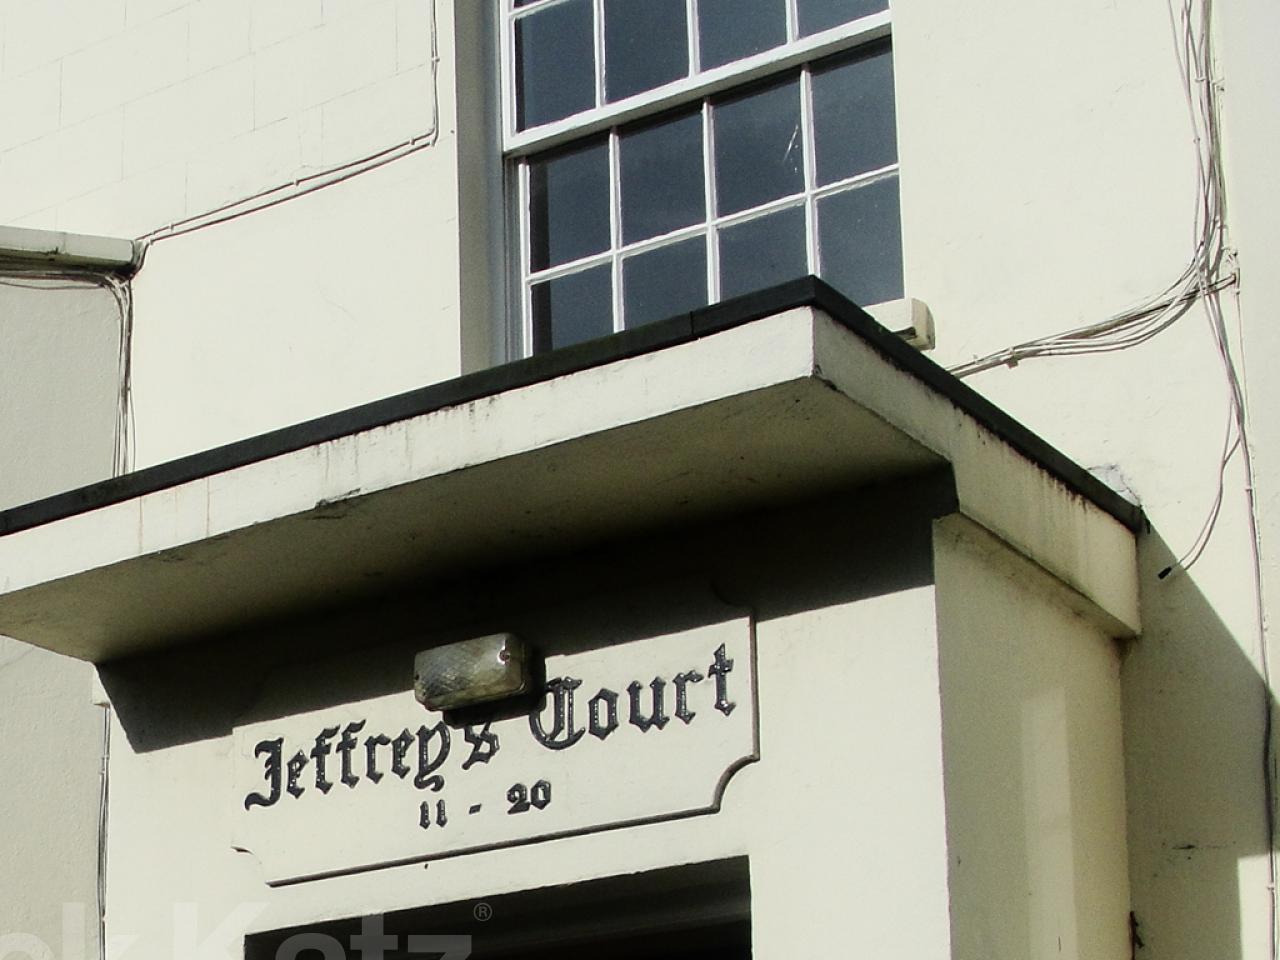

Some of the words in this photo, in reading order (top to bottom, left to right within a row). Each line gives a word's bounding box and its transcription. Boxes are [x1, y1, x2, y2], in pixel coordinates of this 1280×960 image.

[529, 643, 736, 751] Court
[419, 799, 448, 829] 11
[507, 779, 551, 813] 20
